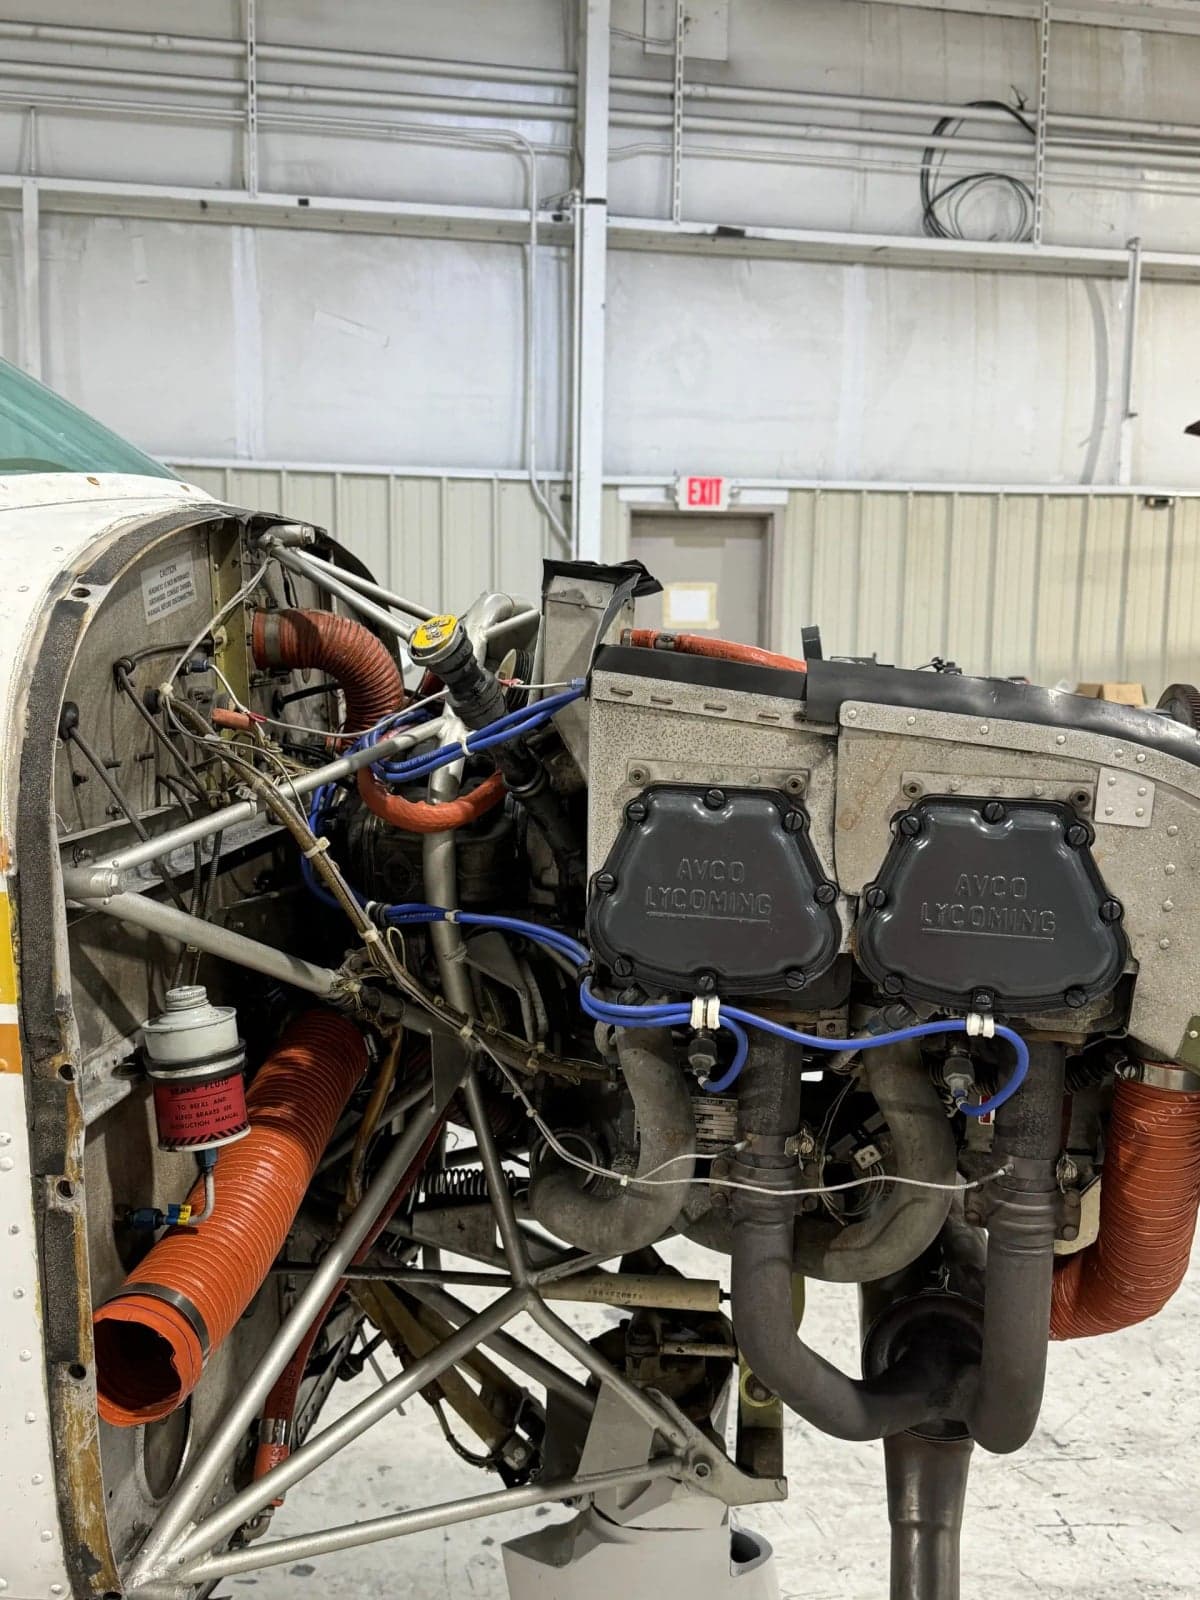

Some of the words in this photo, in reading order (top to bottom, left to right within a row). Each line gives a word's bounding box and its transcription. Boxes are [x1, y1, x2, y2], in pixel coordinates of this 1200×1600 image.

[688, 478, 722, 505] EXIT
[159, 564, 177, 578] CAUTION
[679, 857, 746, 884] AVCO
[953, 872, 1029, 900] AVCO
[645, 885, 773, 917] LYCOMING
[920, 901, 1057, 934] LYCOMING
